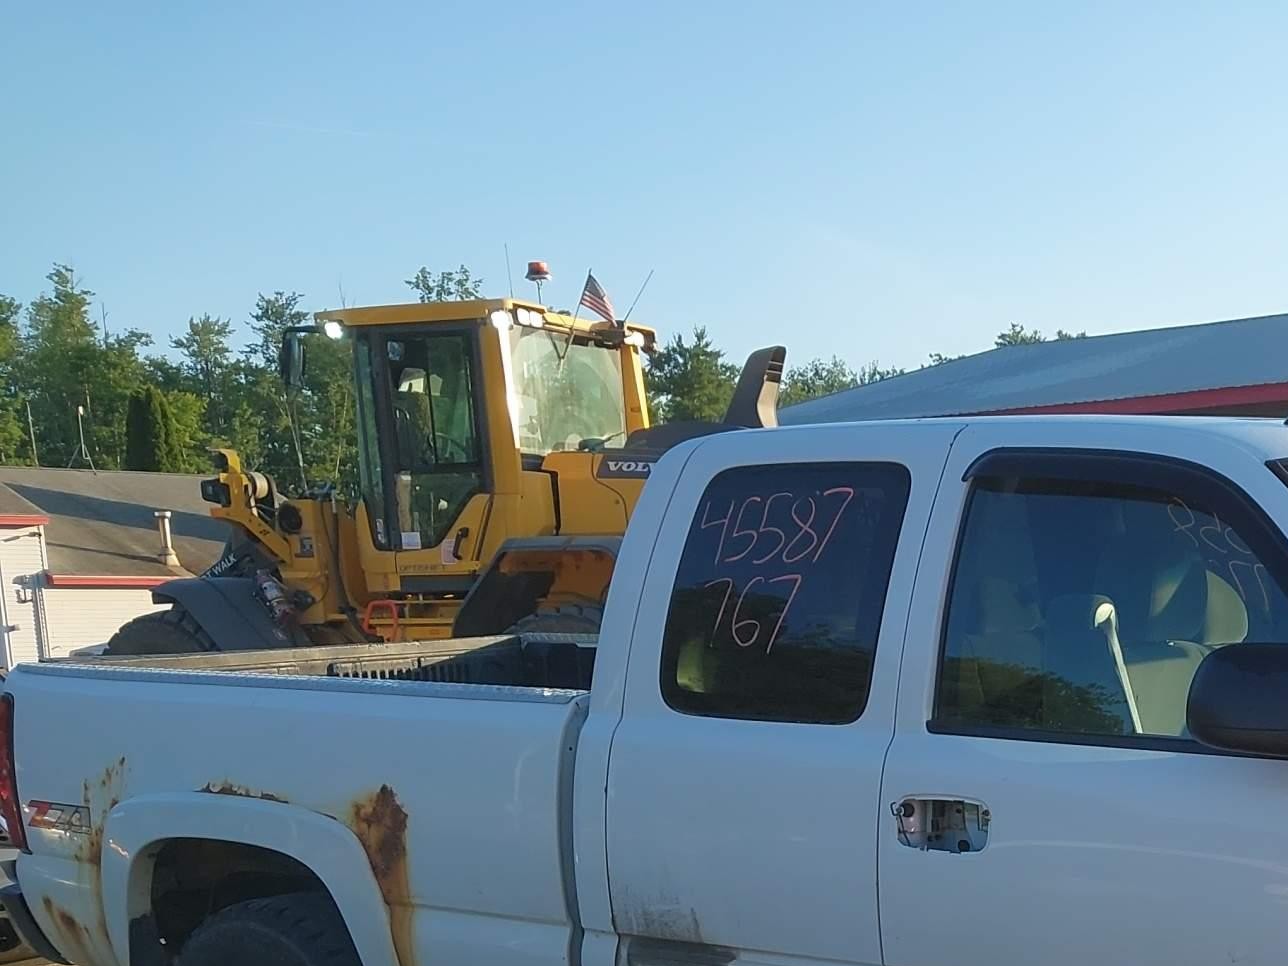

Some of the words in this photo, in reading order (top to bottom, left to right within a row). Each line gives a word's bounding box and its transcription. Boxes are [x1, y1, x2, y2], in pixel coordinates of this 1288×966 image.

[212, 552, 237, 576] WALK
[701, 486, 854, 566] 45587
[704, 574, 802, 655] 767
